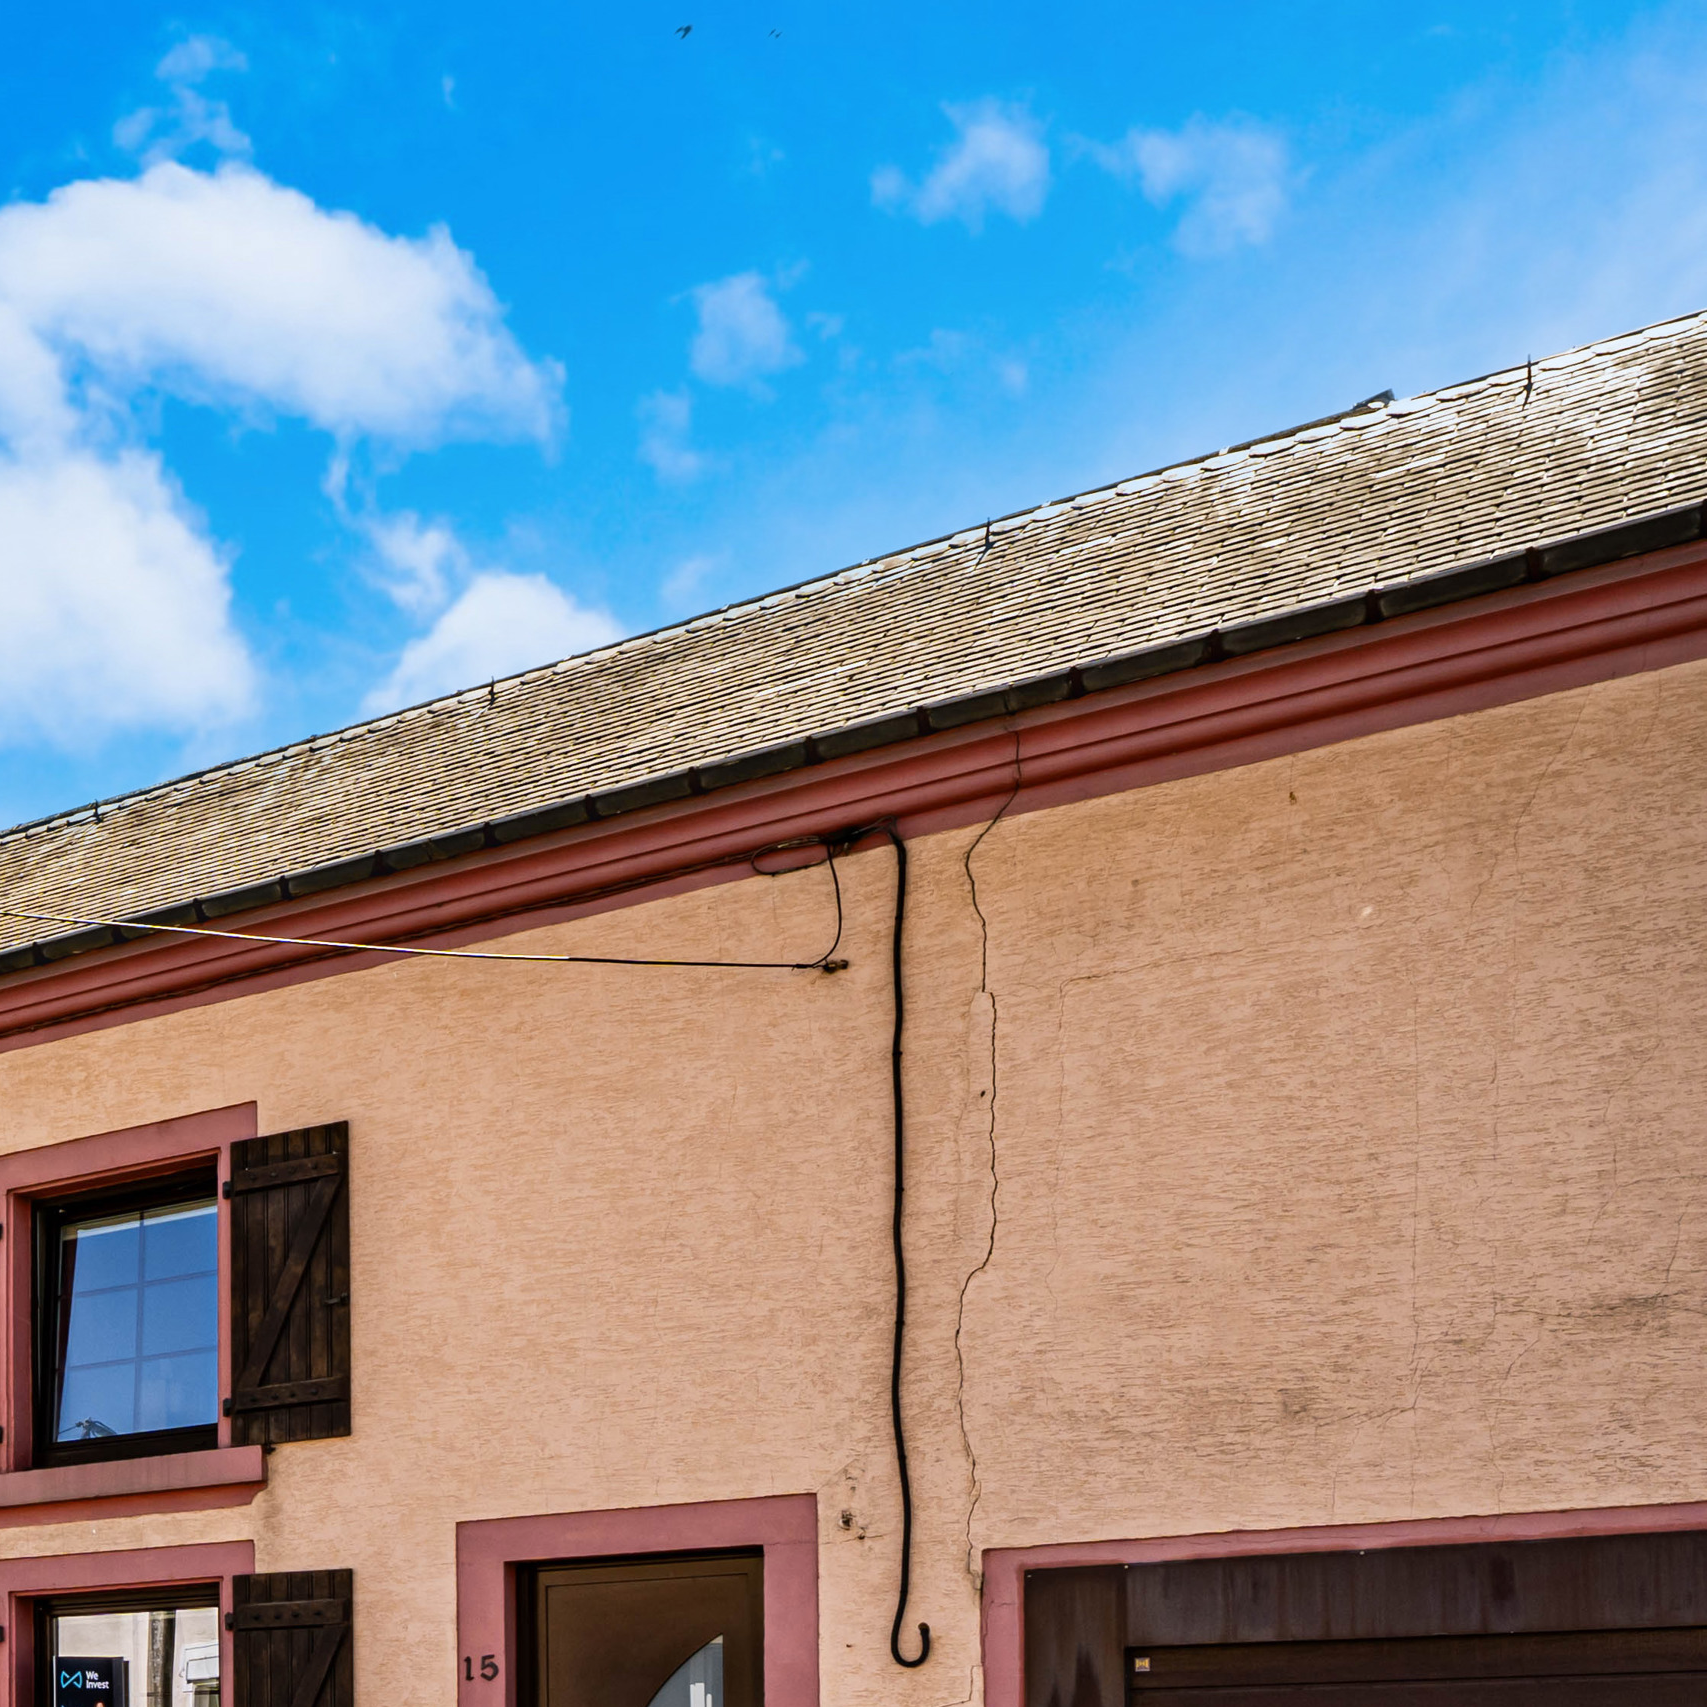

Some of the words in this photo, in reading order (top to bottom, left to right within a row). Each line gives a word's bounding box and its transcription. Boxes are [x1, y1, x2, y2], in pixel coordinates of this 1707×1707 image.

[464, 1654, 499, 1682] 15
[86, 1671, 99, 1680] We
[86, 1680, 109, 1689] Invest
